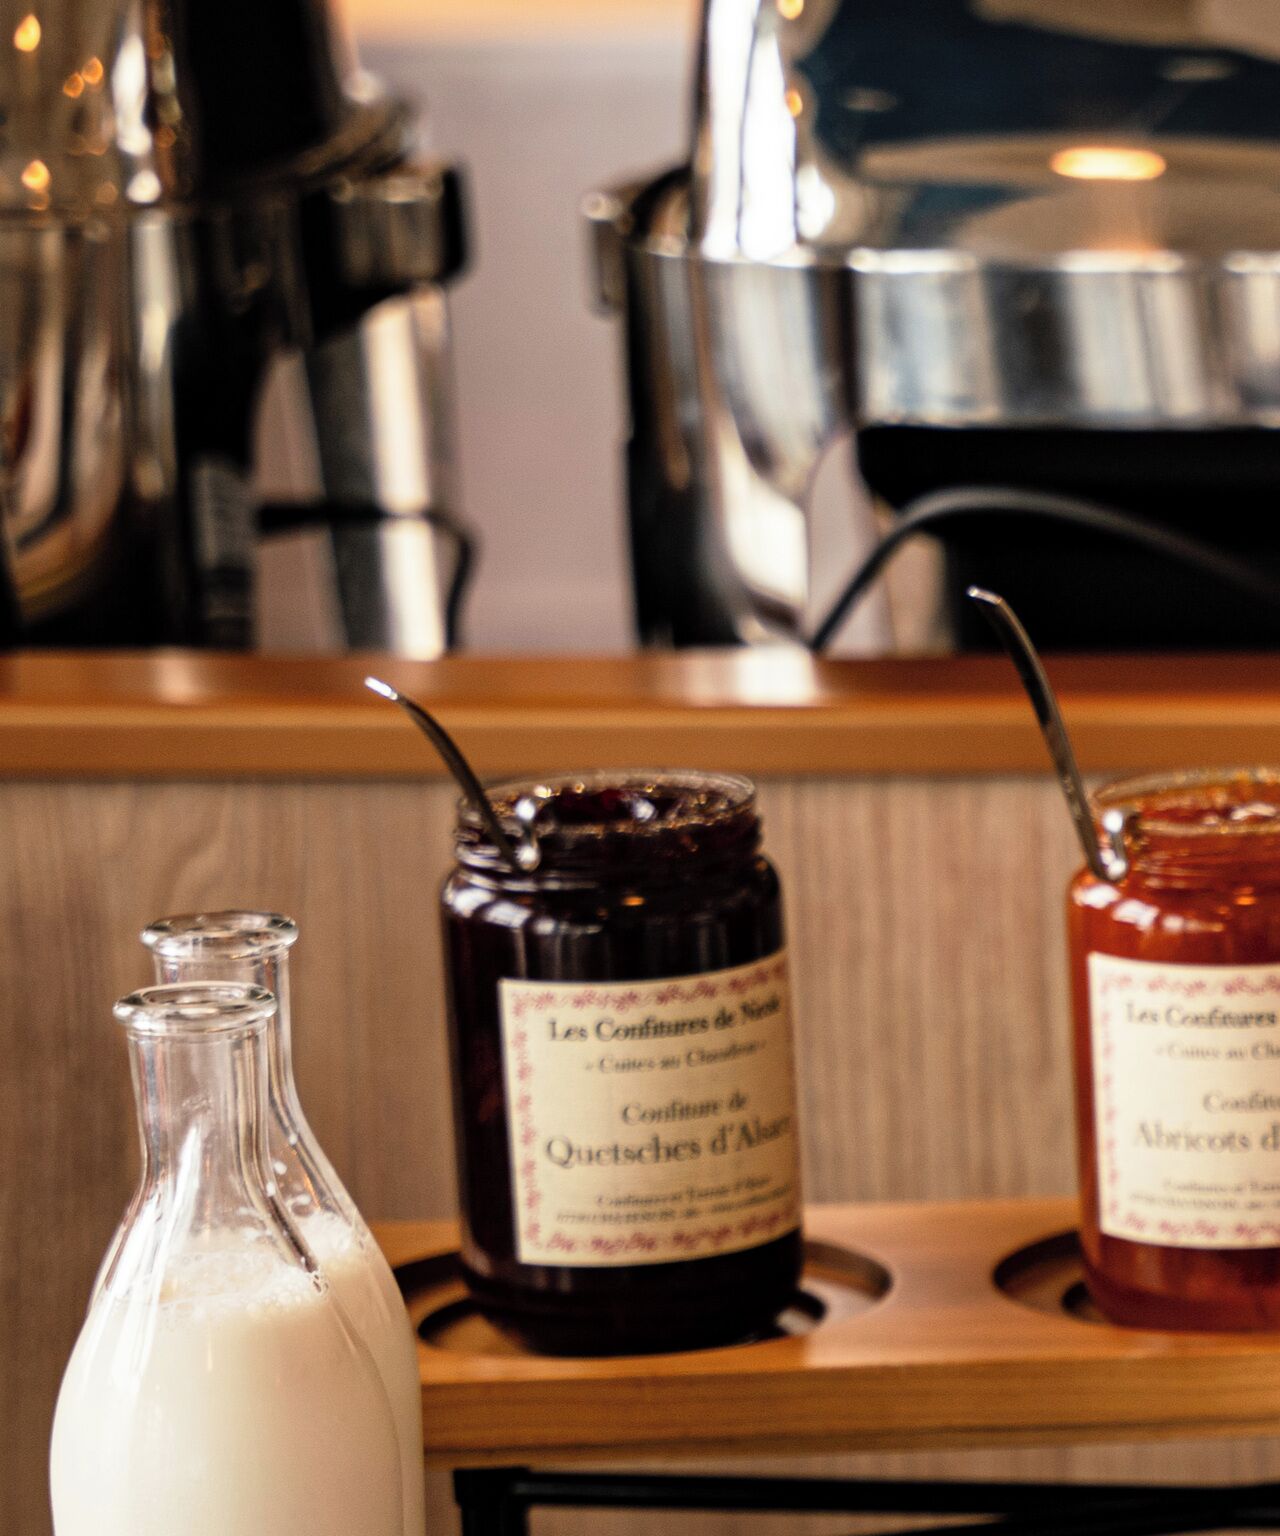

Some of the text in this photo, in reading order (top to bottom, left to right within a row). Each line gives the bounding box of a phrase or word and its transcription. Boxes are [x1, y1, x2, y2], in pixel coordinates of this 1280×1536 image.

[547, 1016, 589, 1042] Les
[594, 1012, 710, 1042] Confitures
[714, 1006, 735, 1029] de
[1125, 1000, 1159, 1024] Les
[1164, 1004, 1277, 1030] Confitures
[621, 1089, 748, 1126] Confiture de
[545, 1134, 701, 1170] Quetsches
[1134, 1118, 1251, 1153] Abricots
